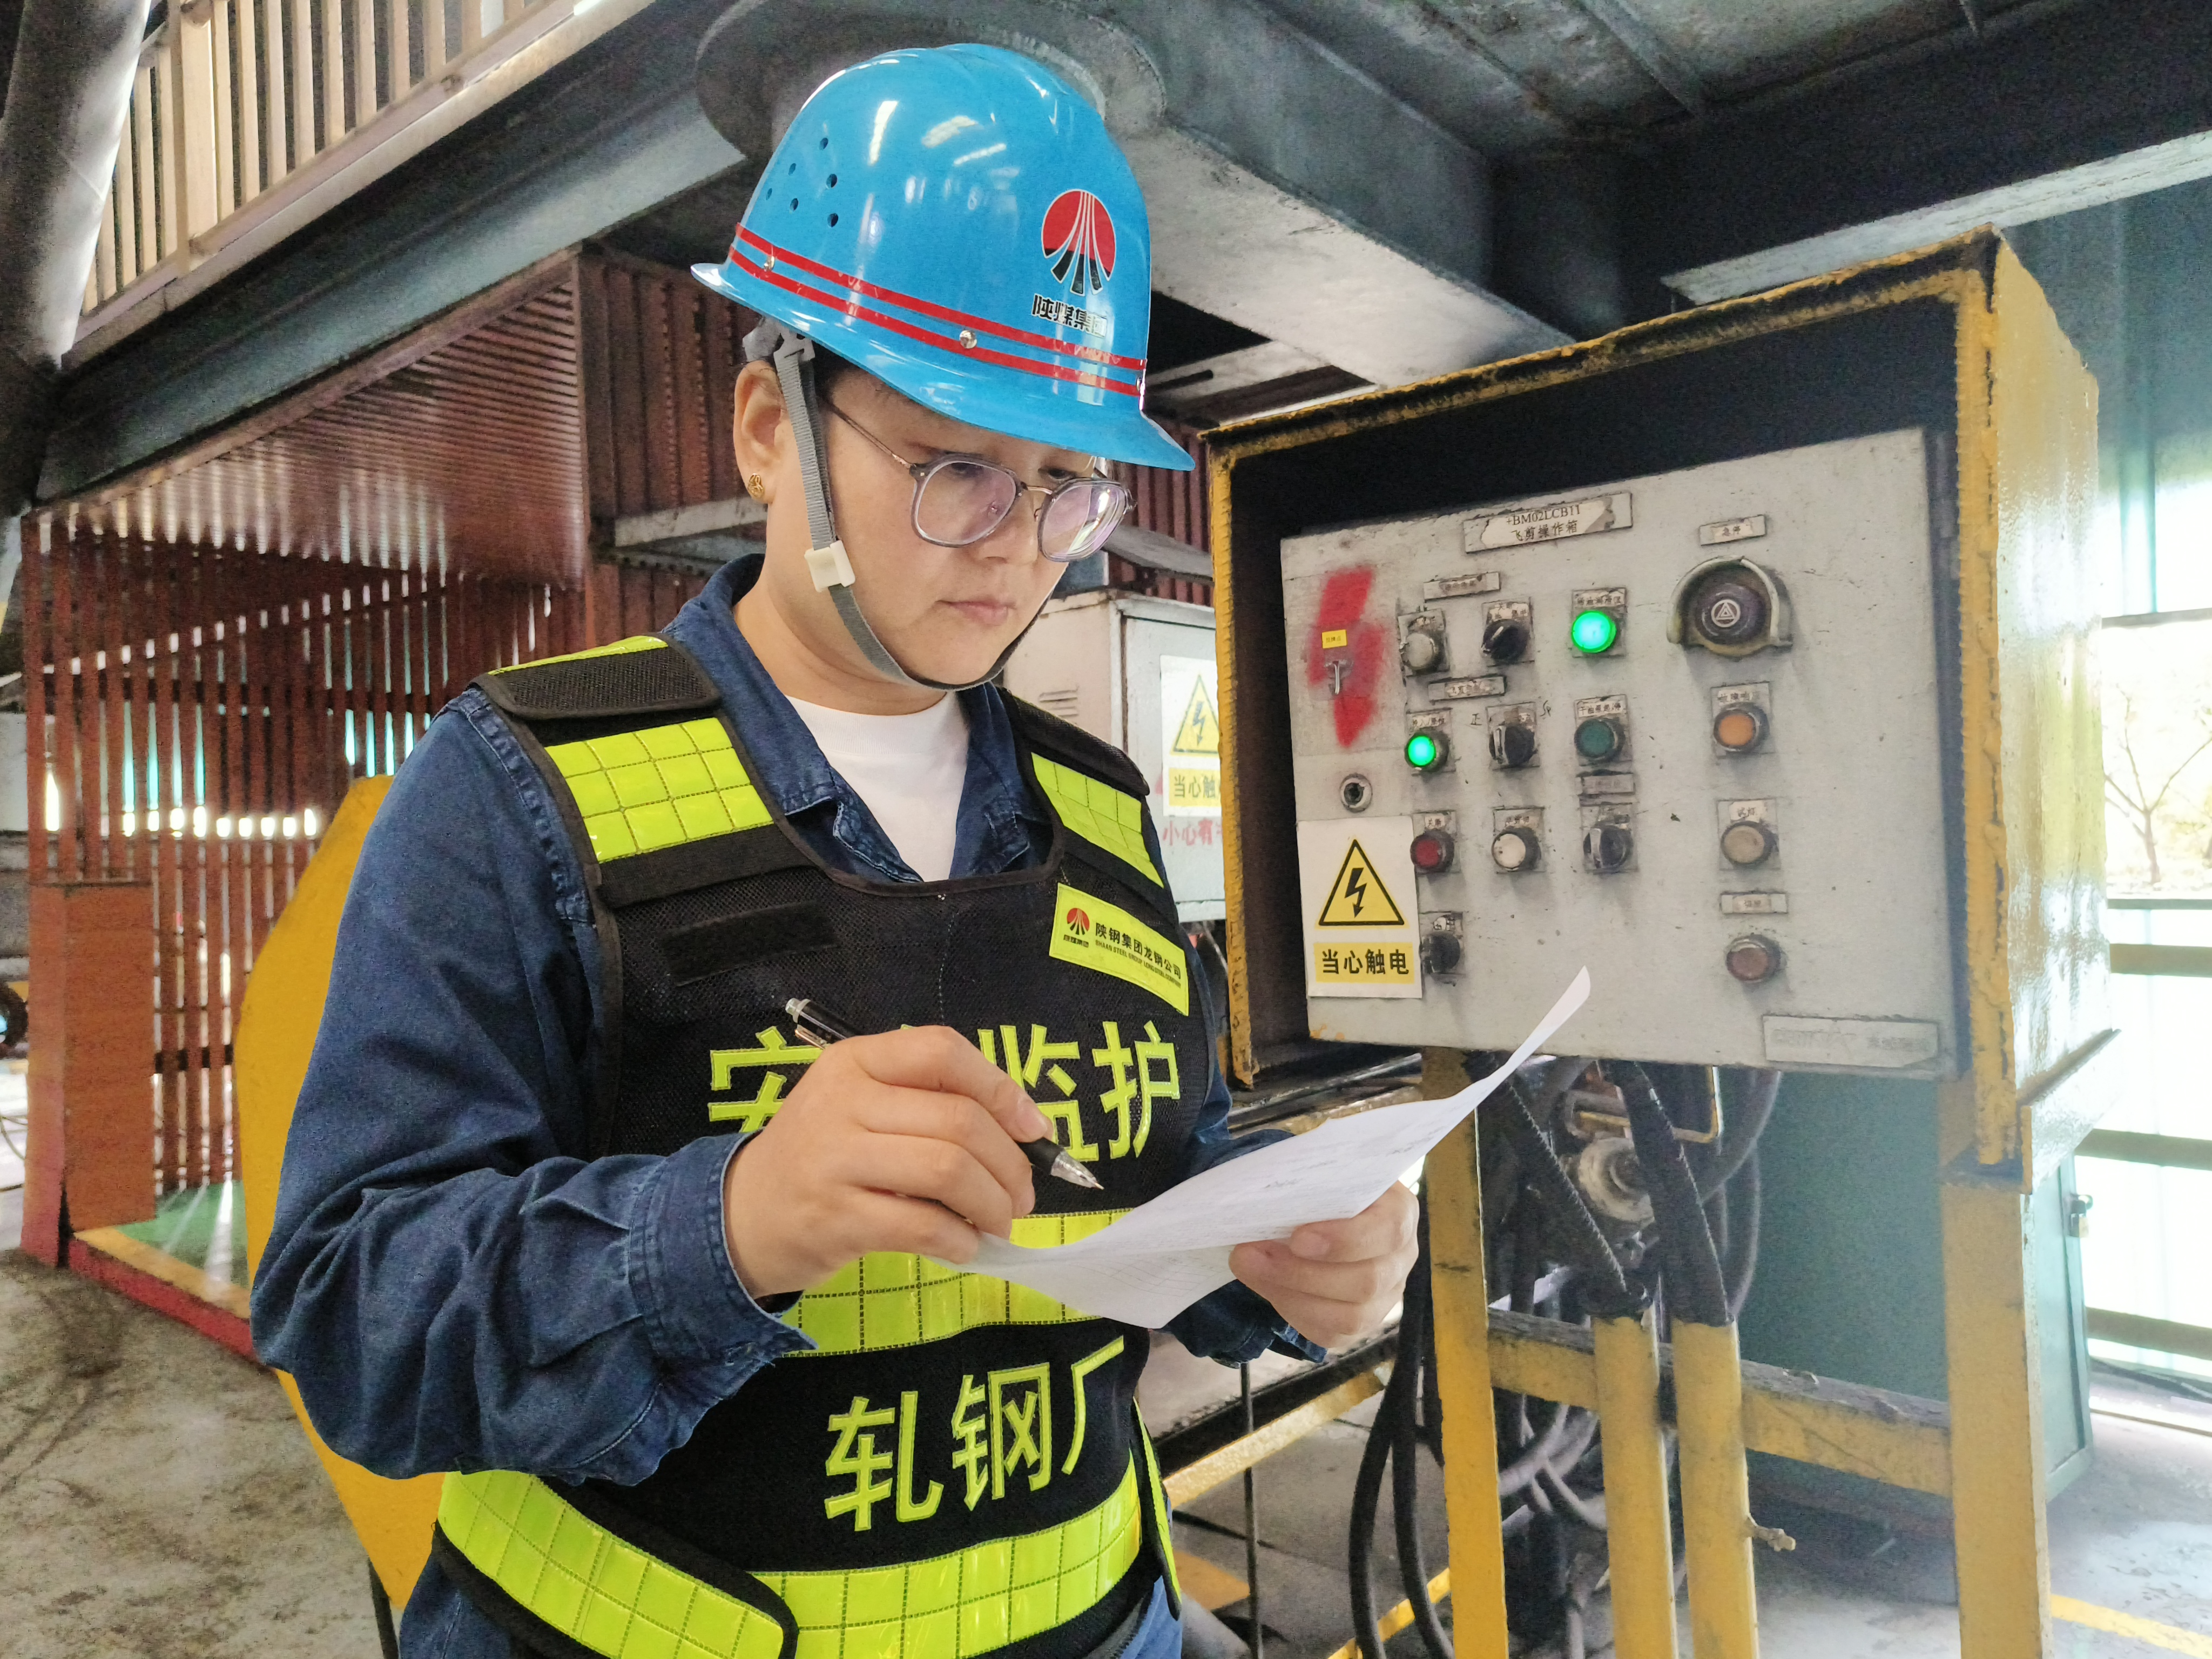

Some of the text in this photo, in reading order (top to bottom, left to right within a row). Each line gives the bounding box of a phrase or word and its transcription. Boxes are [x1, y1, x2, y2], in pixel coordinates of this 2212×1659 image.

[1510, 520, 1578, 542] 飞剪操作箱
[1174, 774, 1220, 799] 当心触
[1095, 940, 1112, 952] SHAAN
[1113, 947, 1128, 957] STEEL
[1095, 922, 1181, 980] 陕钢集团龙钢公司
[1321, 949, 1409, 975] 当心触电
[708, 1021, 1181, 1162] 安监护
[824, 1336, 1124, 1531] 轧钢厂
